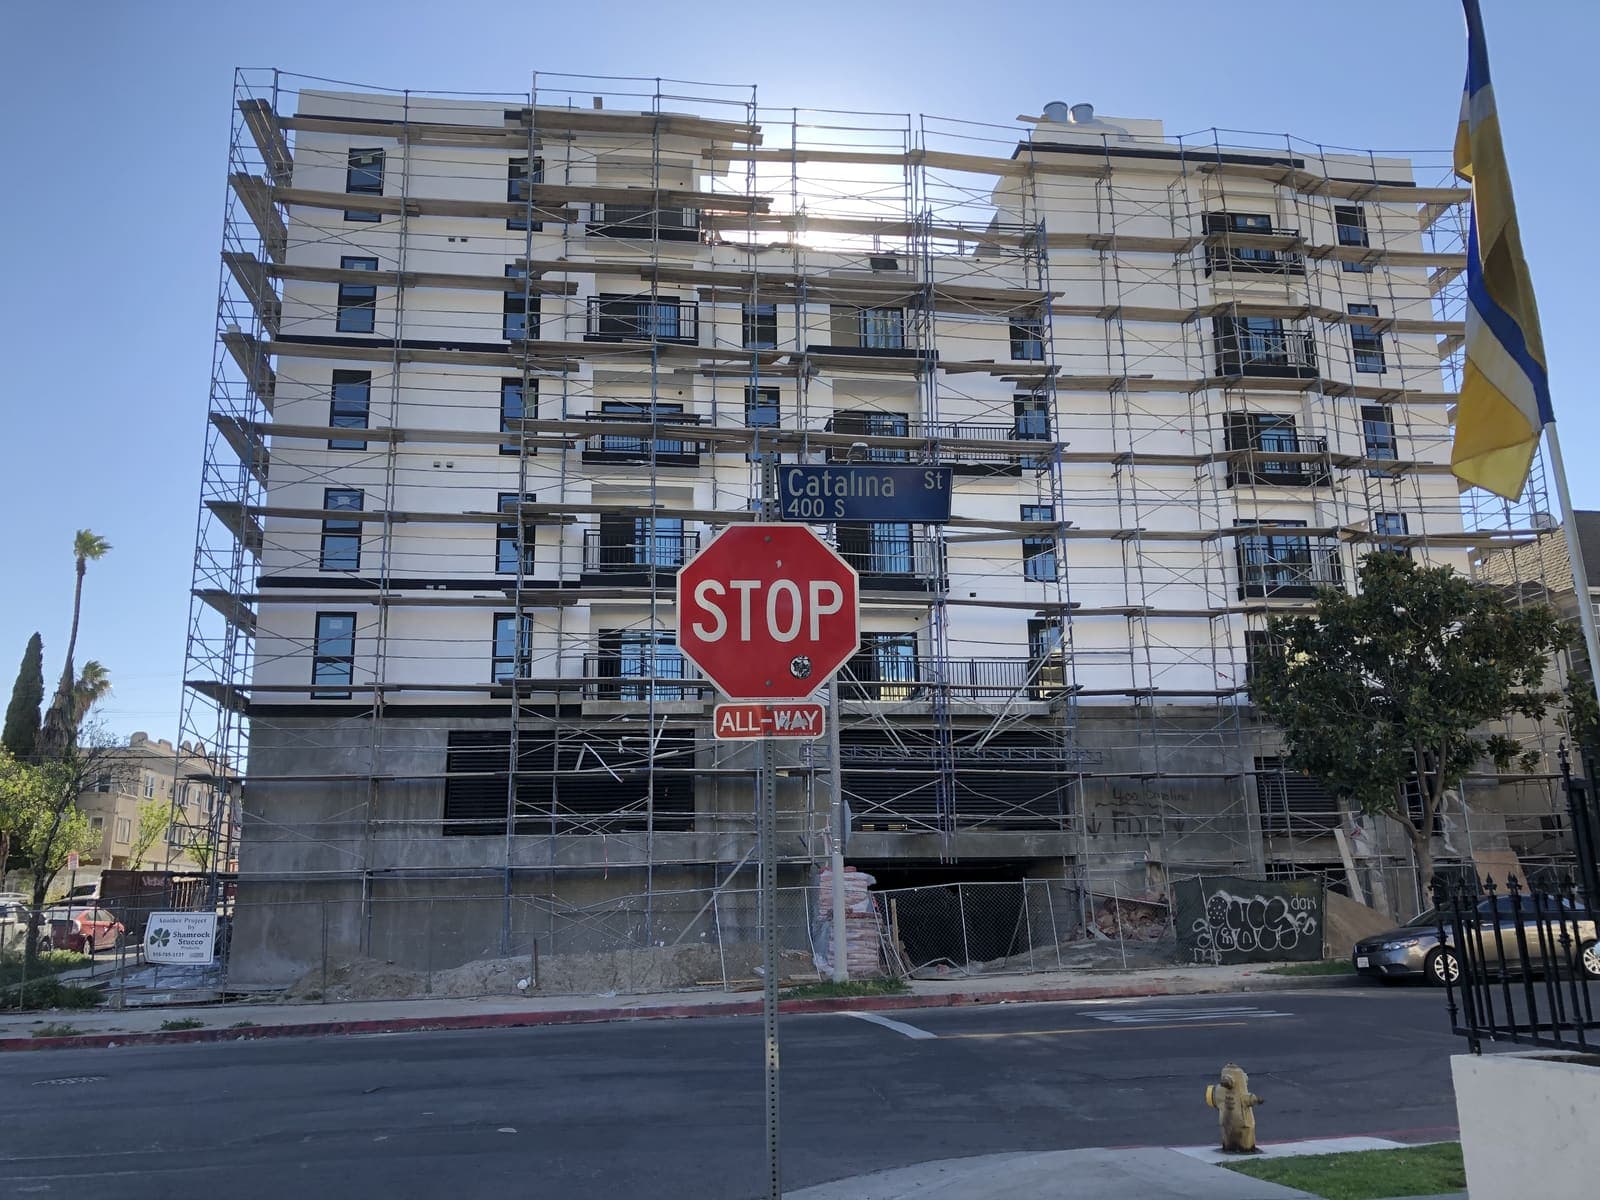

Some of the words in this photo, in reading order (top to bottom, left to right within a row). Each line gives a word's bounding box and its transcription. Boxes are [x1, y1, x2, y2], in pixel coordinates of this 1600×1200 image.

[788, 468, 895, 498] Catalina
[923, 471, 944, 490] St
[787, 499, 825, 518] 400
[834, 499, 846, 518] S
[692, 578, 844, 643] STOP
[719, 710, 819, 732] ALL-WAY
[184, 917, 207, 925] Project
